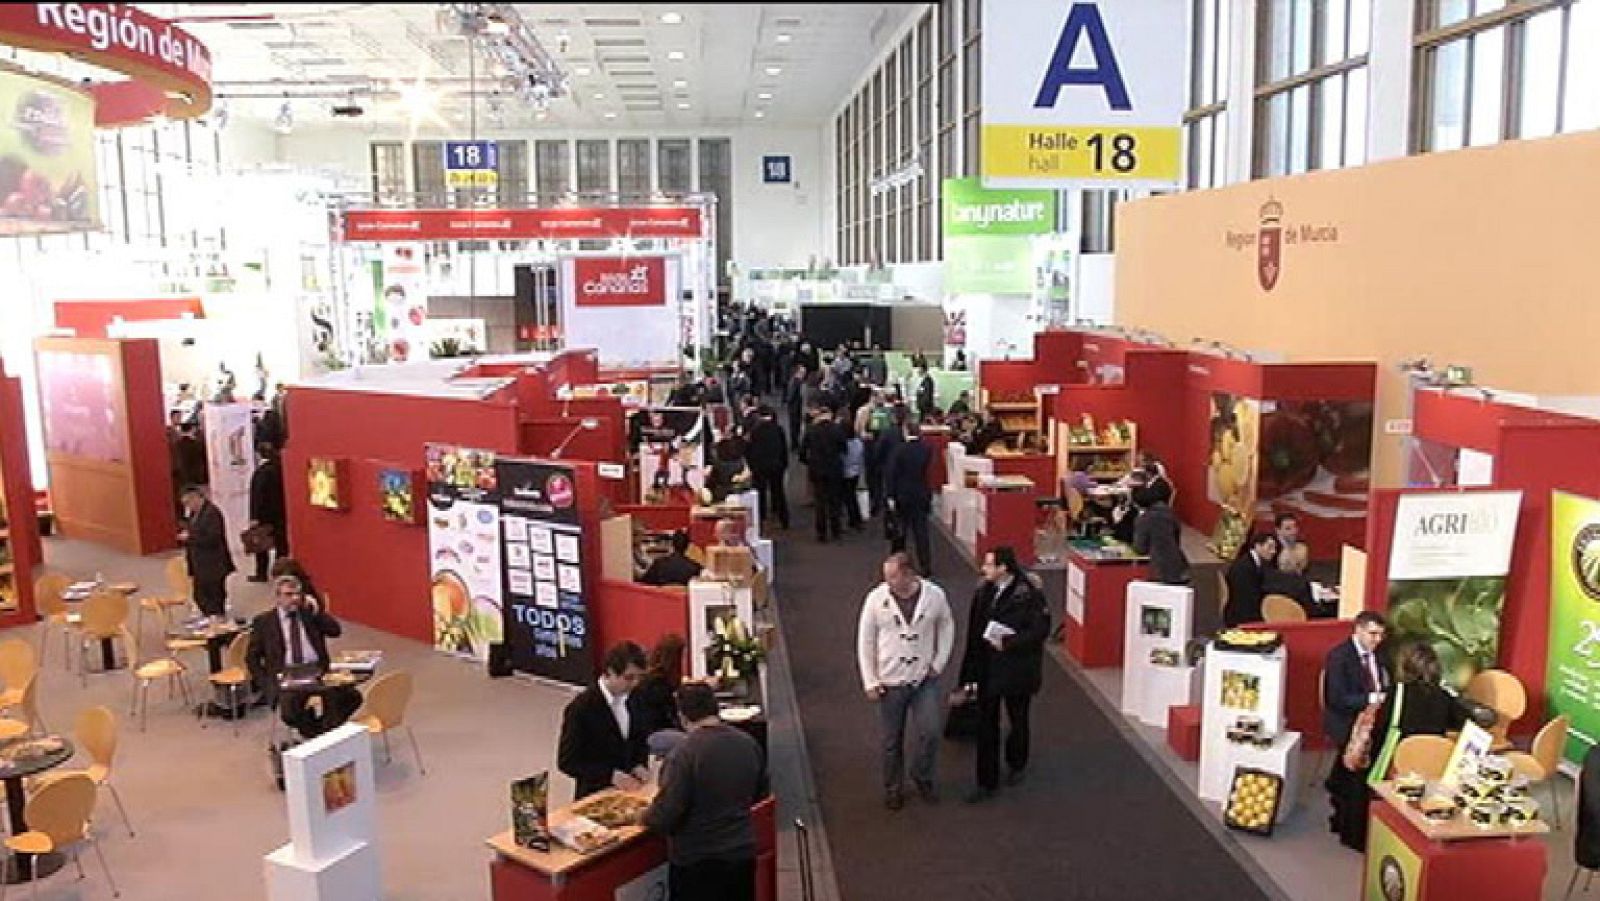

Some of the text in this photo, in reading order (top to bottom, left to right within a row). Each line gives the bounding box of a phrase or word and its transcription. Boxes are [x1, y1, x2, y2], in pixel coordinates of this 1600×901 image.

[159, 27, 183, 67] de
[1033, 2, 1133, 111] A
[454, 145, 481, 166] 18
[1029, 132, 1078, 151] Halle
[1087, 133, 1136, 173] 18
[1029, 152, 1059, 172] hall
[511, 604, 586, 635] TODOS
